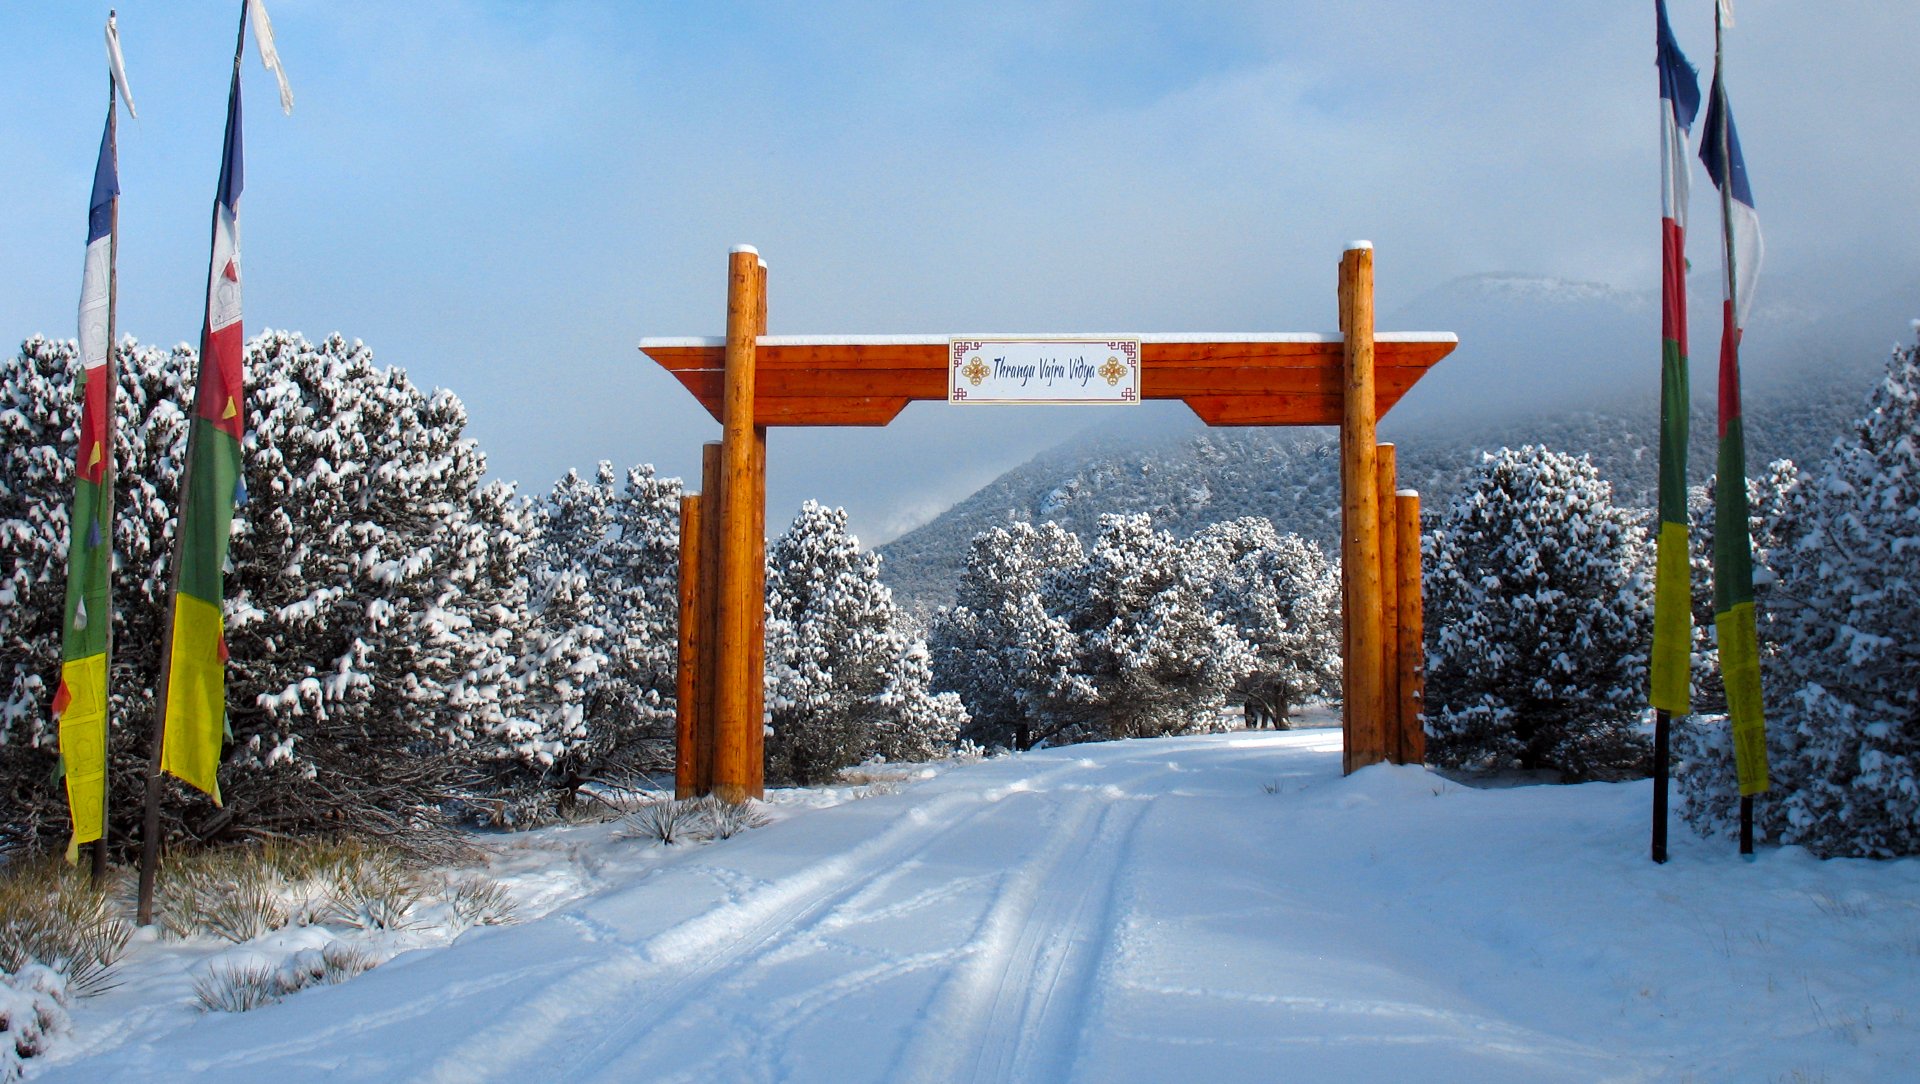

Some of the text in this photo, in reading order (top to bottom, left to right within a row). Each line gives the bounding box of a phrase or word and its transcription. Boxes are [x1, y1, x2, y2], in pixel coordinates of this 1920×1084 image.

[994, 356, 1095, 387] Thrangu Vajra Vidya
